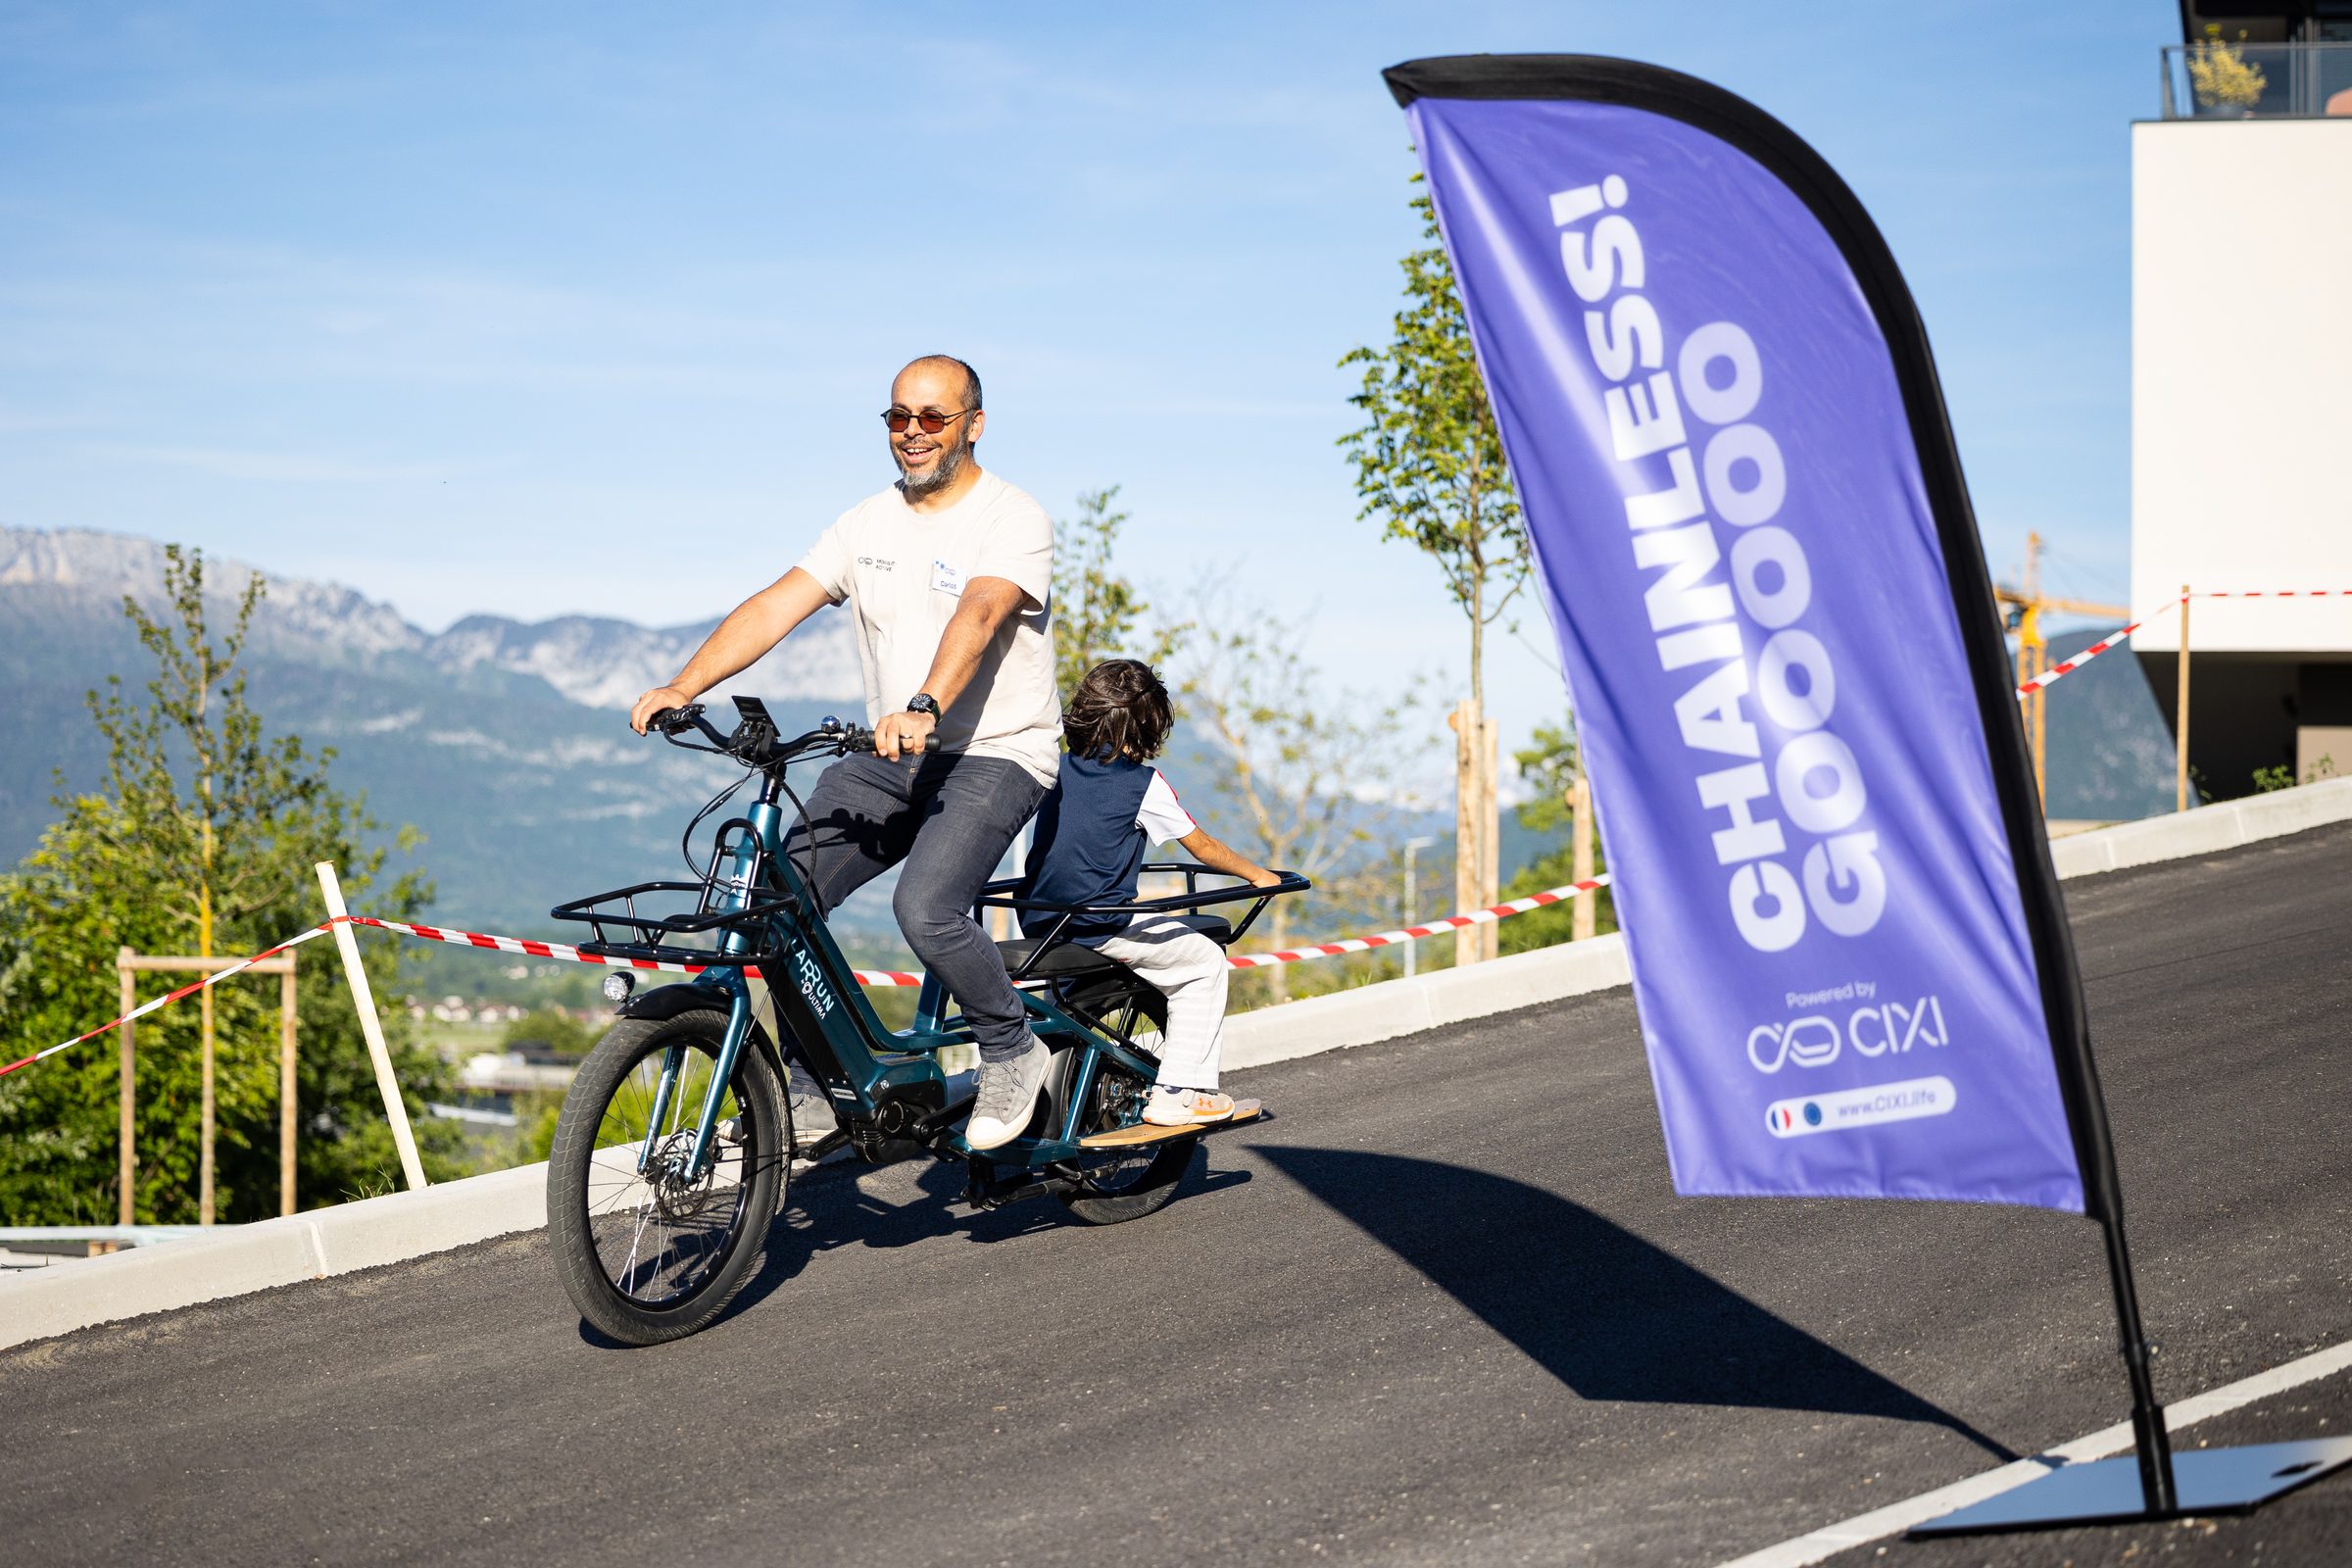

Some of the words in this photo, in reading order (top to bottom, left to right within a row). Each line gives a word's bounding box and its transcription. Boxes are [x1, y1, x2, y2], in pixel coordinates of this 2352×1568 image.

[1548, 172, 1807, 954] CHAINLESS!
[1678, 320, 1887, 938] GOOOOO
[808, 992, 826, 1020] ULTIMA
[1785, 982, 1854, 1009] Powered
[1854, 981, 1877, 999] by
[1848, 995, 1949, 1057] CIXI
[1838, 1090, 1936, 1117] www.CIXI.life
